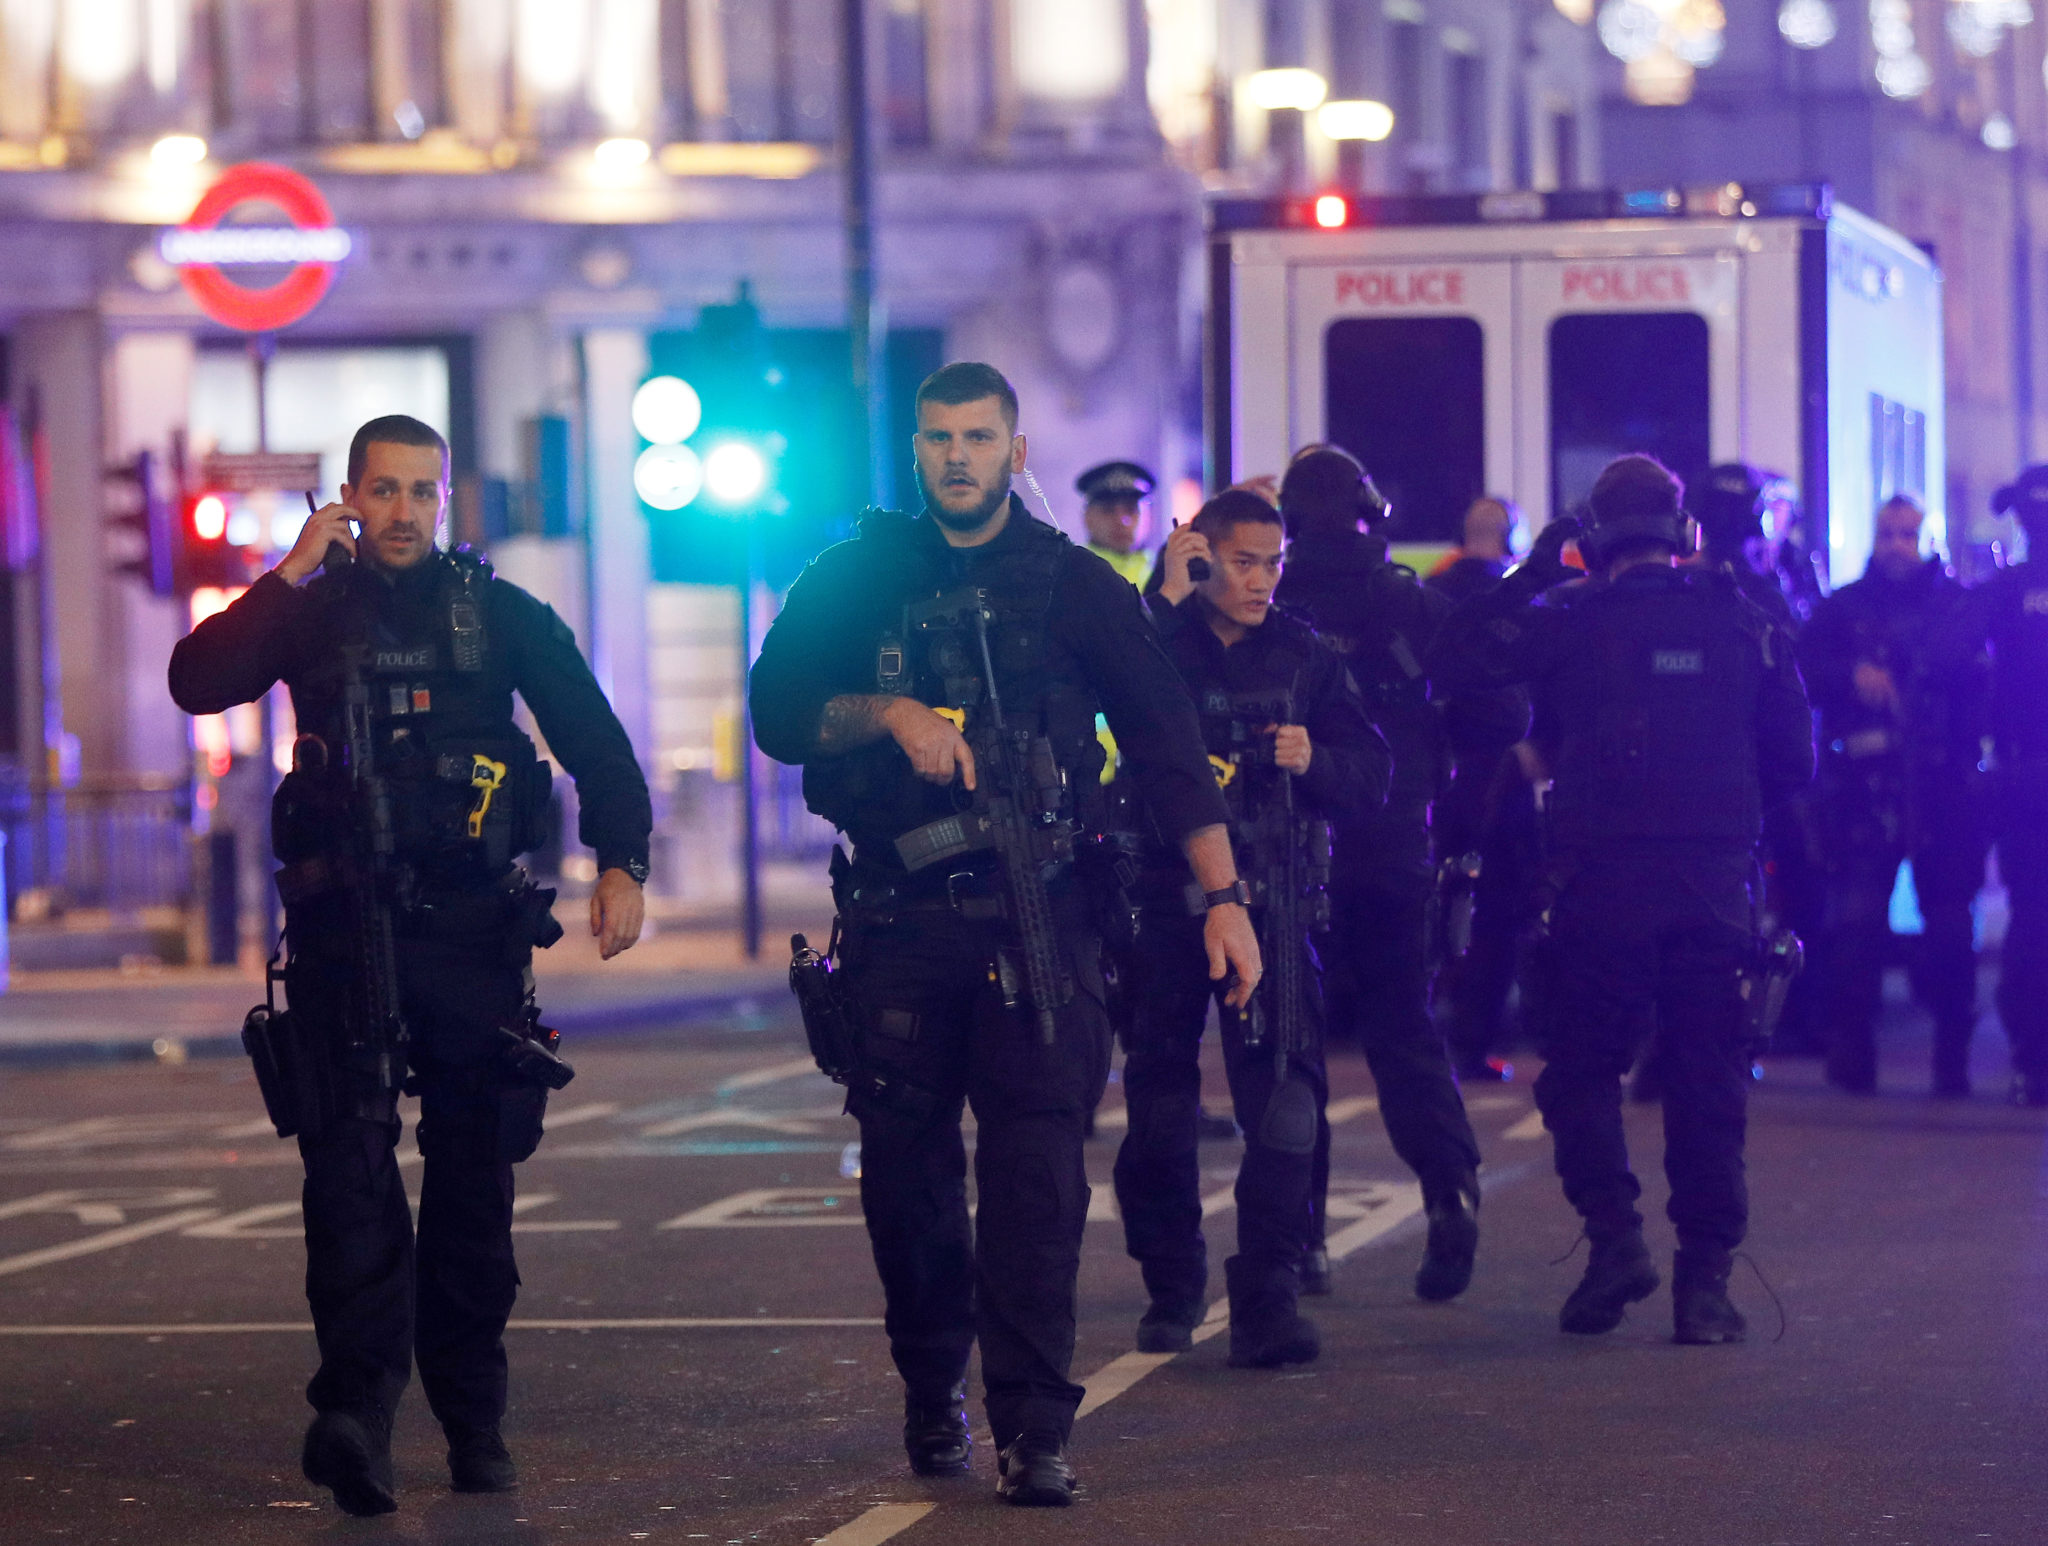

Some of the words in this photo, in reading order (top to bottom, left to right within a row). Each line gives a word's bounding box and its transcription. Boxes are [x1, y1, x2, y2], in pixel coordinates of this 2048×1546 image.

[1336, 270, 1465, 304] POLICE
[1563, 265, 1688, 302] POLICE
[377, 649, 428, 667] POLICE
[1655, 654, 1699, 671] POLICE
